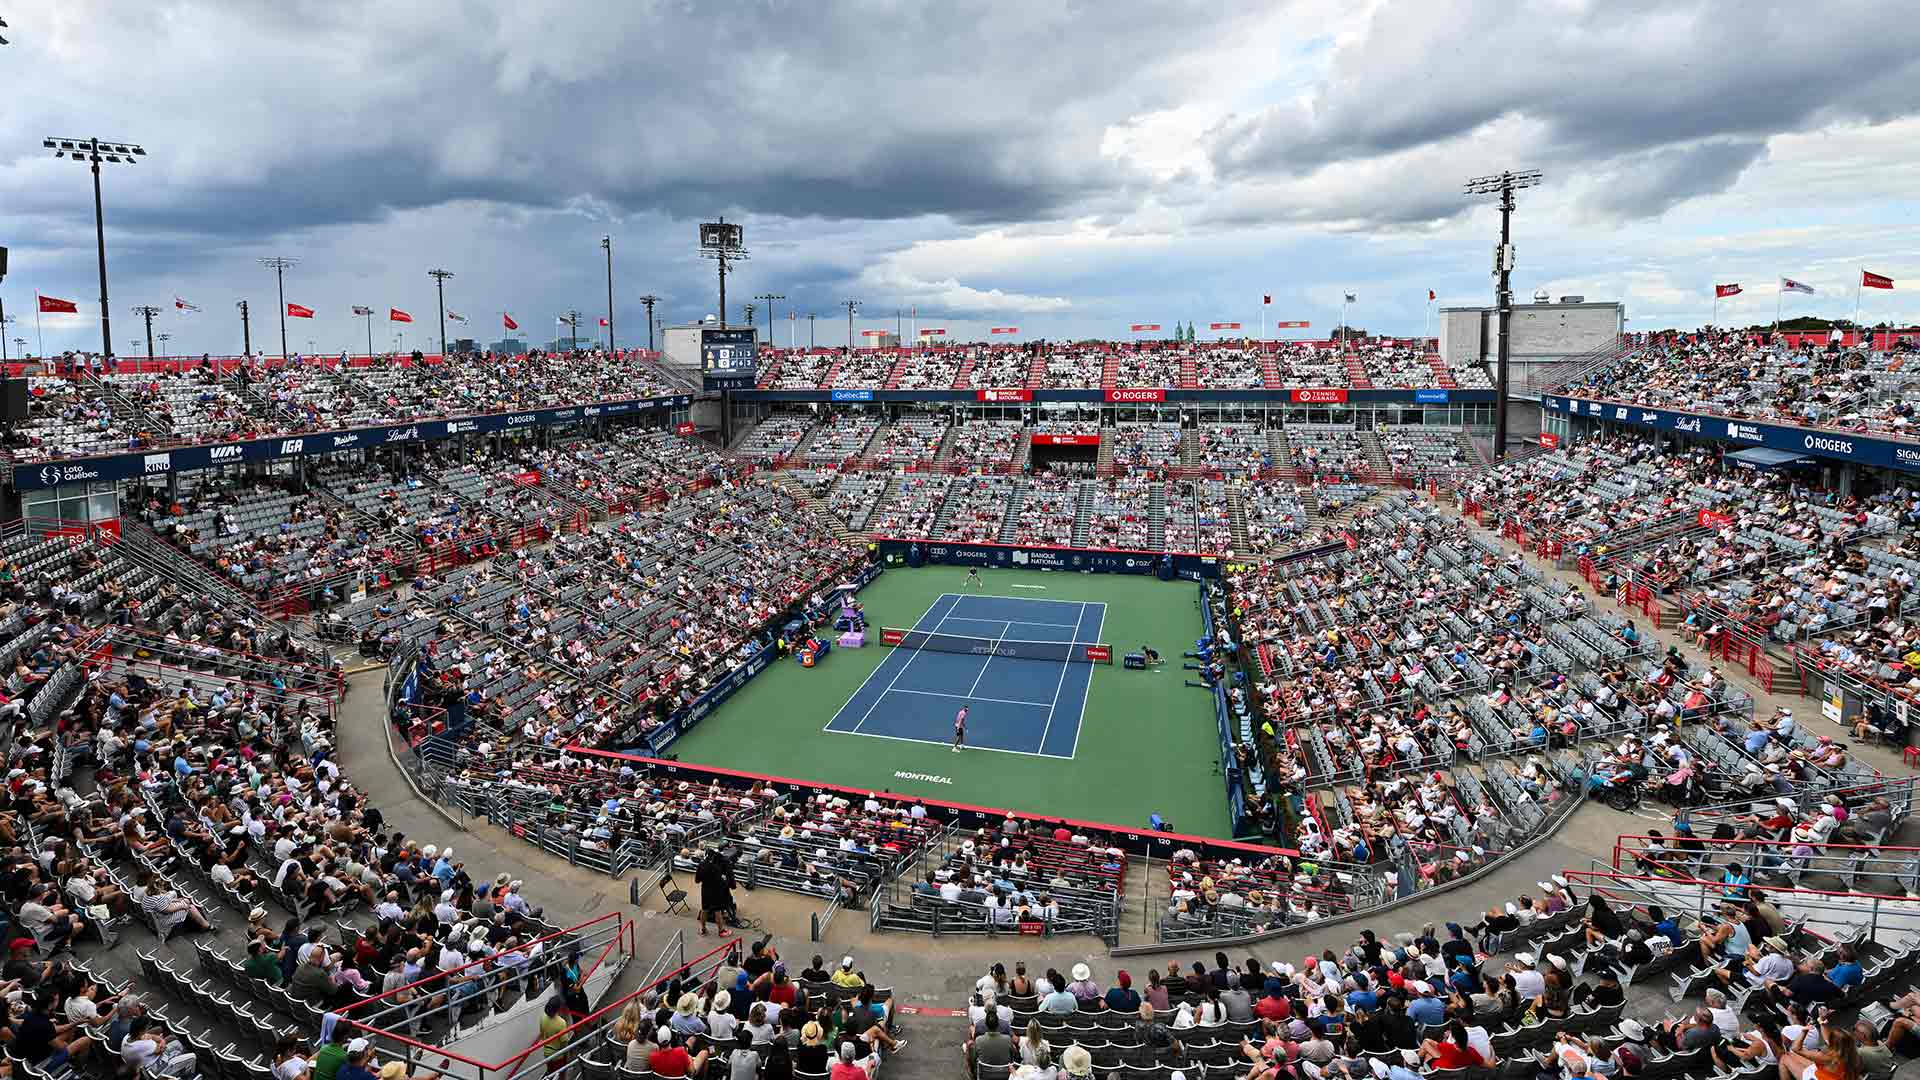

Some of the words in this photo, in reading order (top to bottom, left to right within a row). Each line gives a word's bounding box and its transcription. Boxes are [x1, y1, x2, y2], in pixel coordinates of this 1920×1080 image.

[1122, 391, 1158, 400] ROGERS
[514, 415, 536, 424] ROGERS
[1674, 416, 1697, 431] Lindt
[1739, 424, 1758, 434] BANQUE
[386, 427, 412, 442] Lindt
[1739, 432, 1764, 442] NATIONALE
[281, 439, 303, 455] IGA
[1815, 437, 1853, 454] ROGERS
[210, 446, 235, 458] VIA
[63, 465, 84, 474] Loto
[144, 462, 171, 473] KIND
[63, 471, 99, 481] Québec
[962, 551, 988, 559] ROGERS
[1030, 552, 1056, 560] BANQUE
[1030, 558, 1065, 566] NATIONALE
